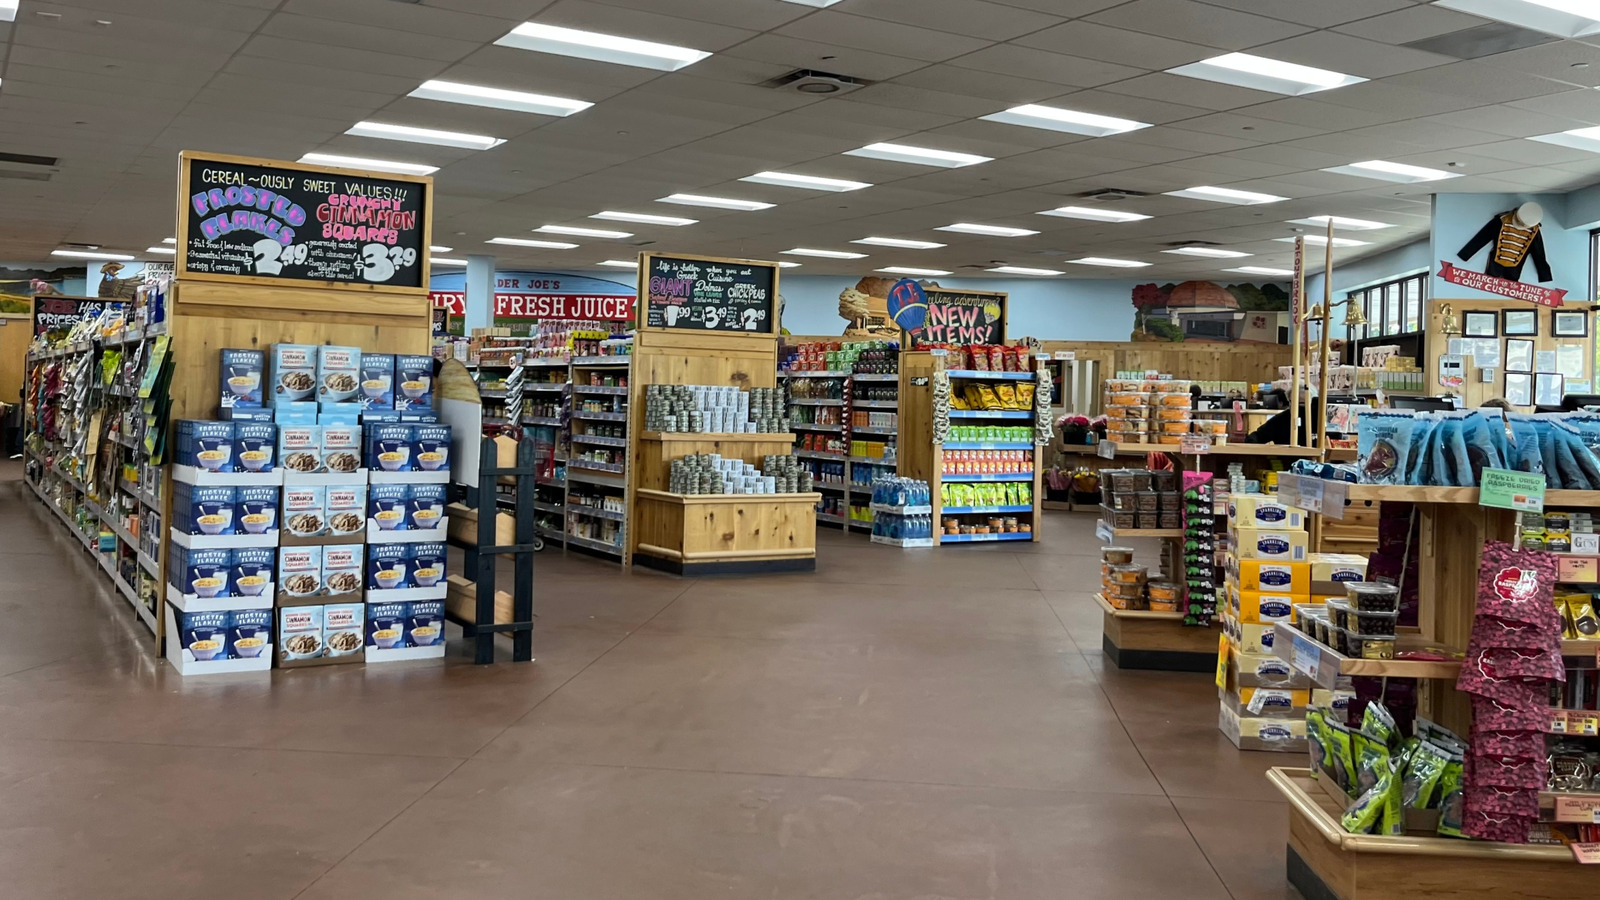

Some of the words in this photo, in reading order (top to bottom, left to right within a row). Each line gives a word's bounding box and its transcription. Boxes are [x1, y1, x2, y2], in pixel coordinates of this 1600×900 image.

[303, 179, 336, 194] SWEET
[345, 182, 407, 201] VALUES!!!
[192, 185, 306, 227] FROSTED
[328, 194, 402, 211] CRUNCHY
[316, 203, 416, 230] CINNAMON
[200, 210, 295, 246] FLAKES
[323, 223, 398, 245] SQUARES
[528, 279, 560, 289] JOE'S
[649, 276, 693, 296] GIANT
[694, 279, 724, 292] Dolmas
[1452, 268, 1465, 278] WE
[1467, 274, 1499, 285] MARCH
[1519, 284, 1542, 295] TUNE
[1462, 278, 1483, 288] OUR
[1484, 283, 1543, 302] CUSTOMERS!
[39, 301, 77, 313] JOE
[78, 301, 102, 313] HAS
[496, 295, 566, 316] FRESH
[571, 297, 628, 318] JUICE
[929, 304, 979, 327] NEW
[927, 324, 993, 345] ITEMS!
[1487, 473, 1515, 482] FREEZE
[1519, 477, 1540, 485] DRIED
[1488, 480, 1538, 491] RASPBERRIES
